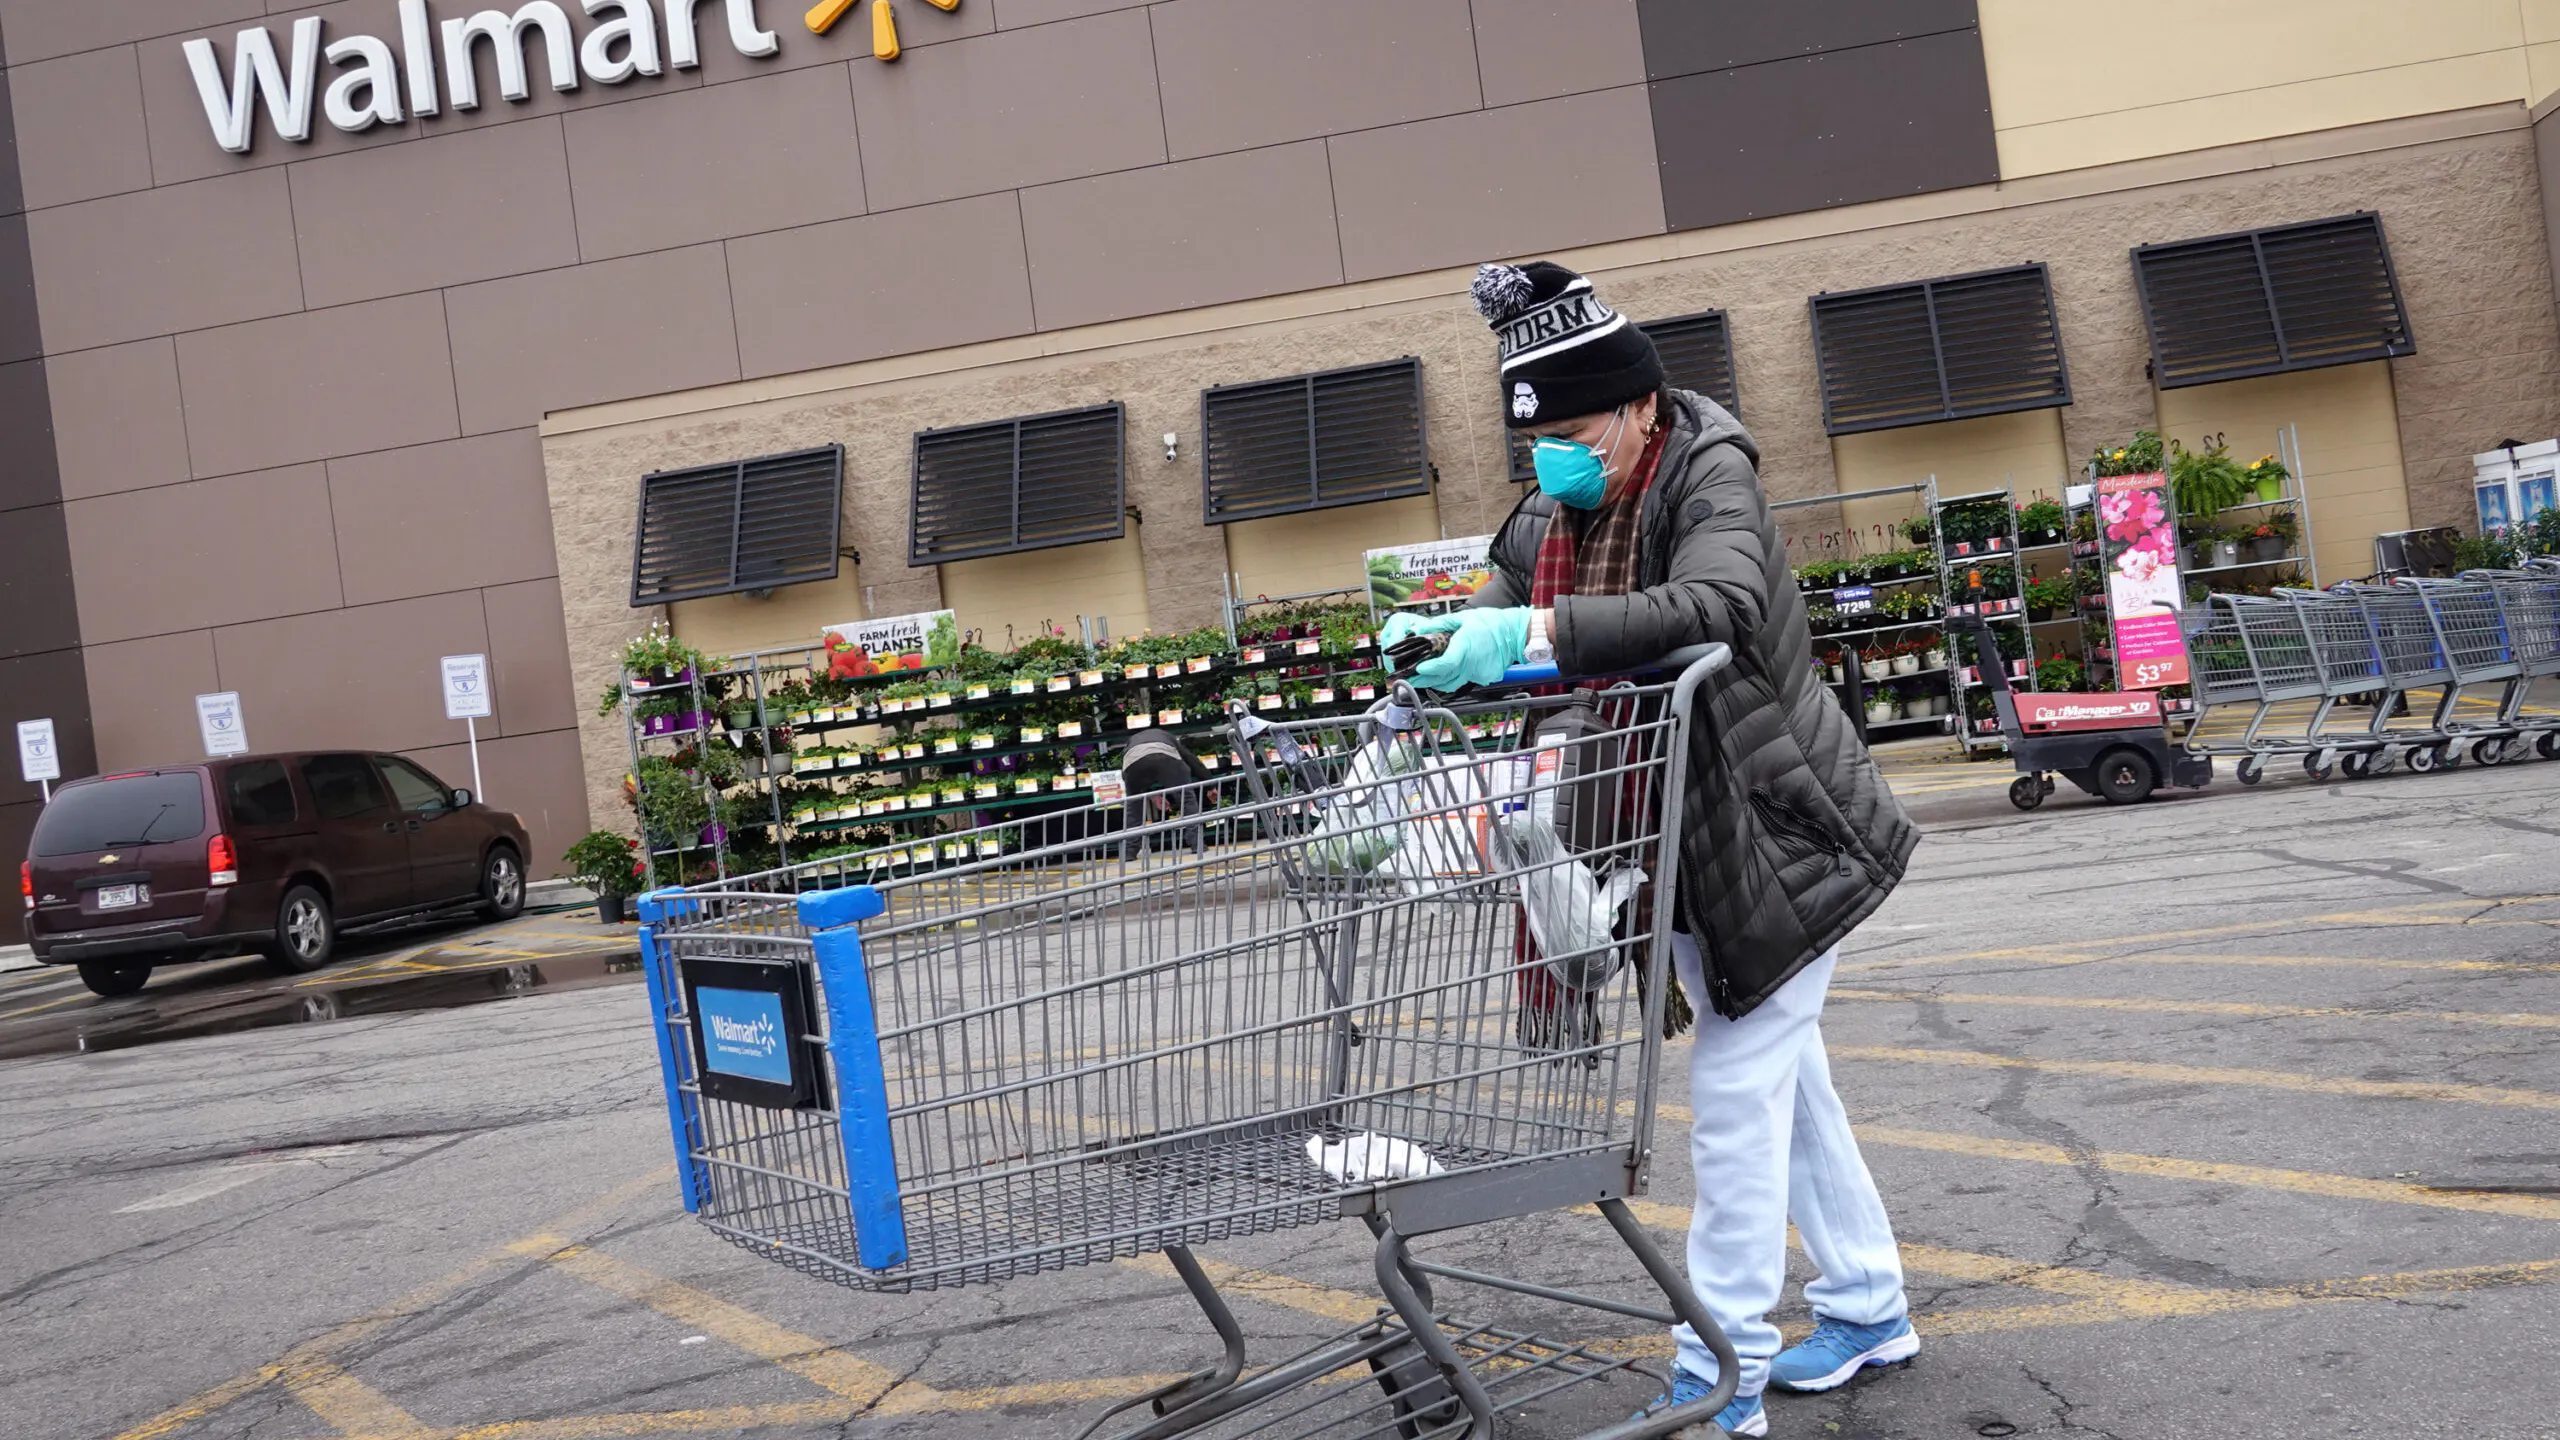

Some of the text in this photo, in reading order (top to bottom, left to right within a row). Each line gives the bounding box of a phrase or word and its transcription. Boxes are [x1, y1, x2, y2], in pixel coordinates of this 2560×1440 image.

[1388, 560, 1496, 580] BONNIE PLANT FARMS
[1409, 553, 1470, 569] fresh FROM
[860, 621, 920, 642] FARM fresh
[861, 635, 924, 655] PLANTS
[710, 1014, 760, 1045] Walmart
